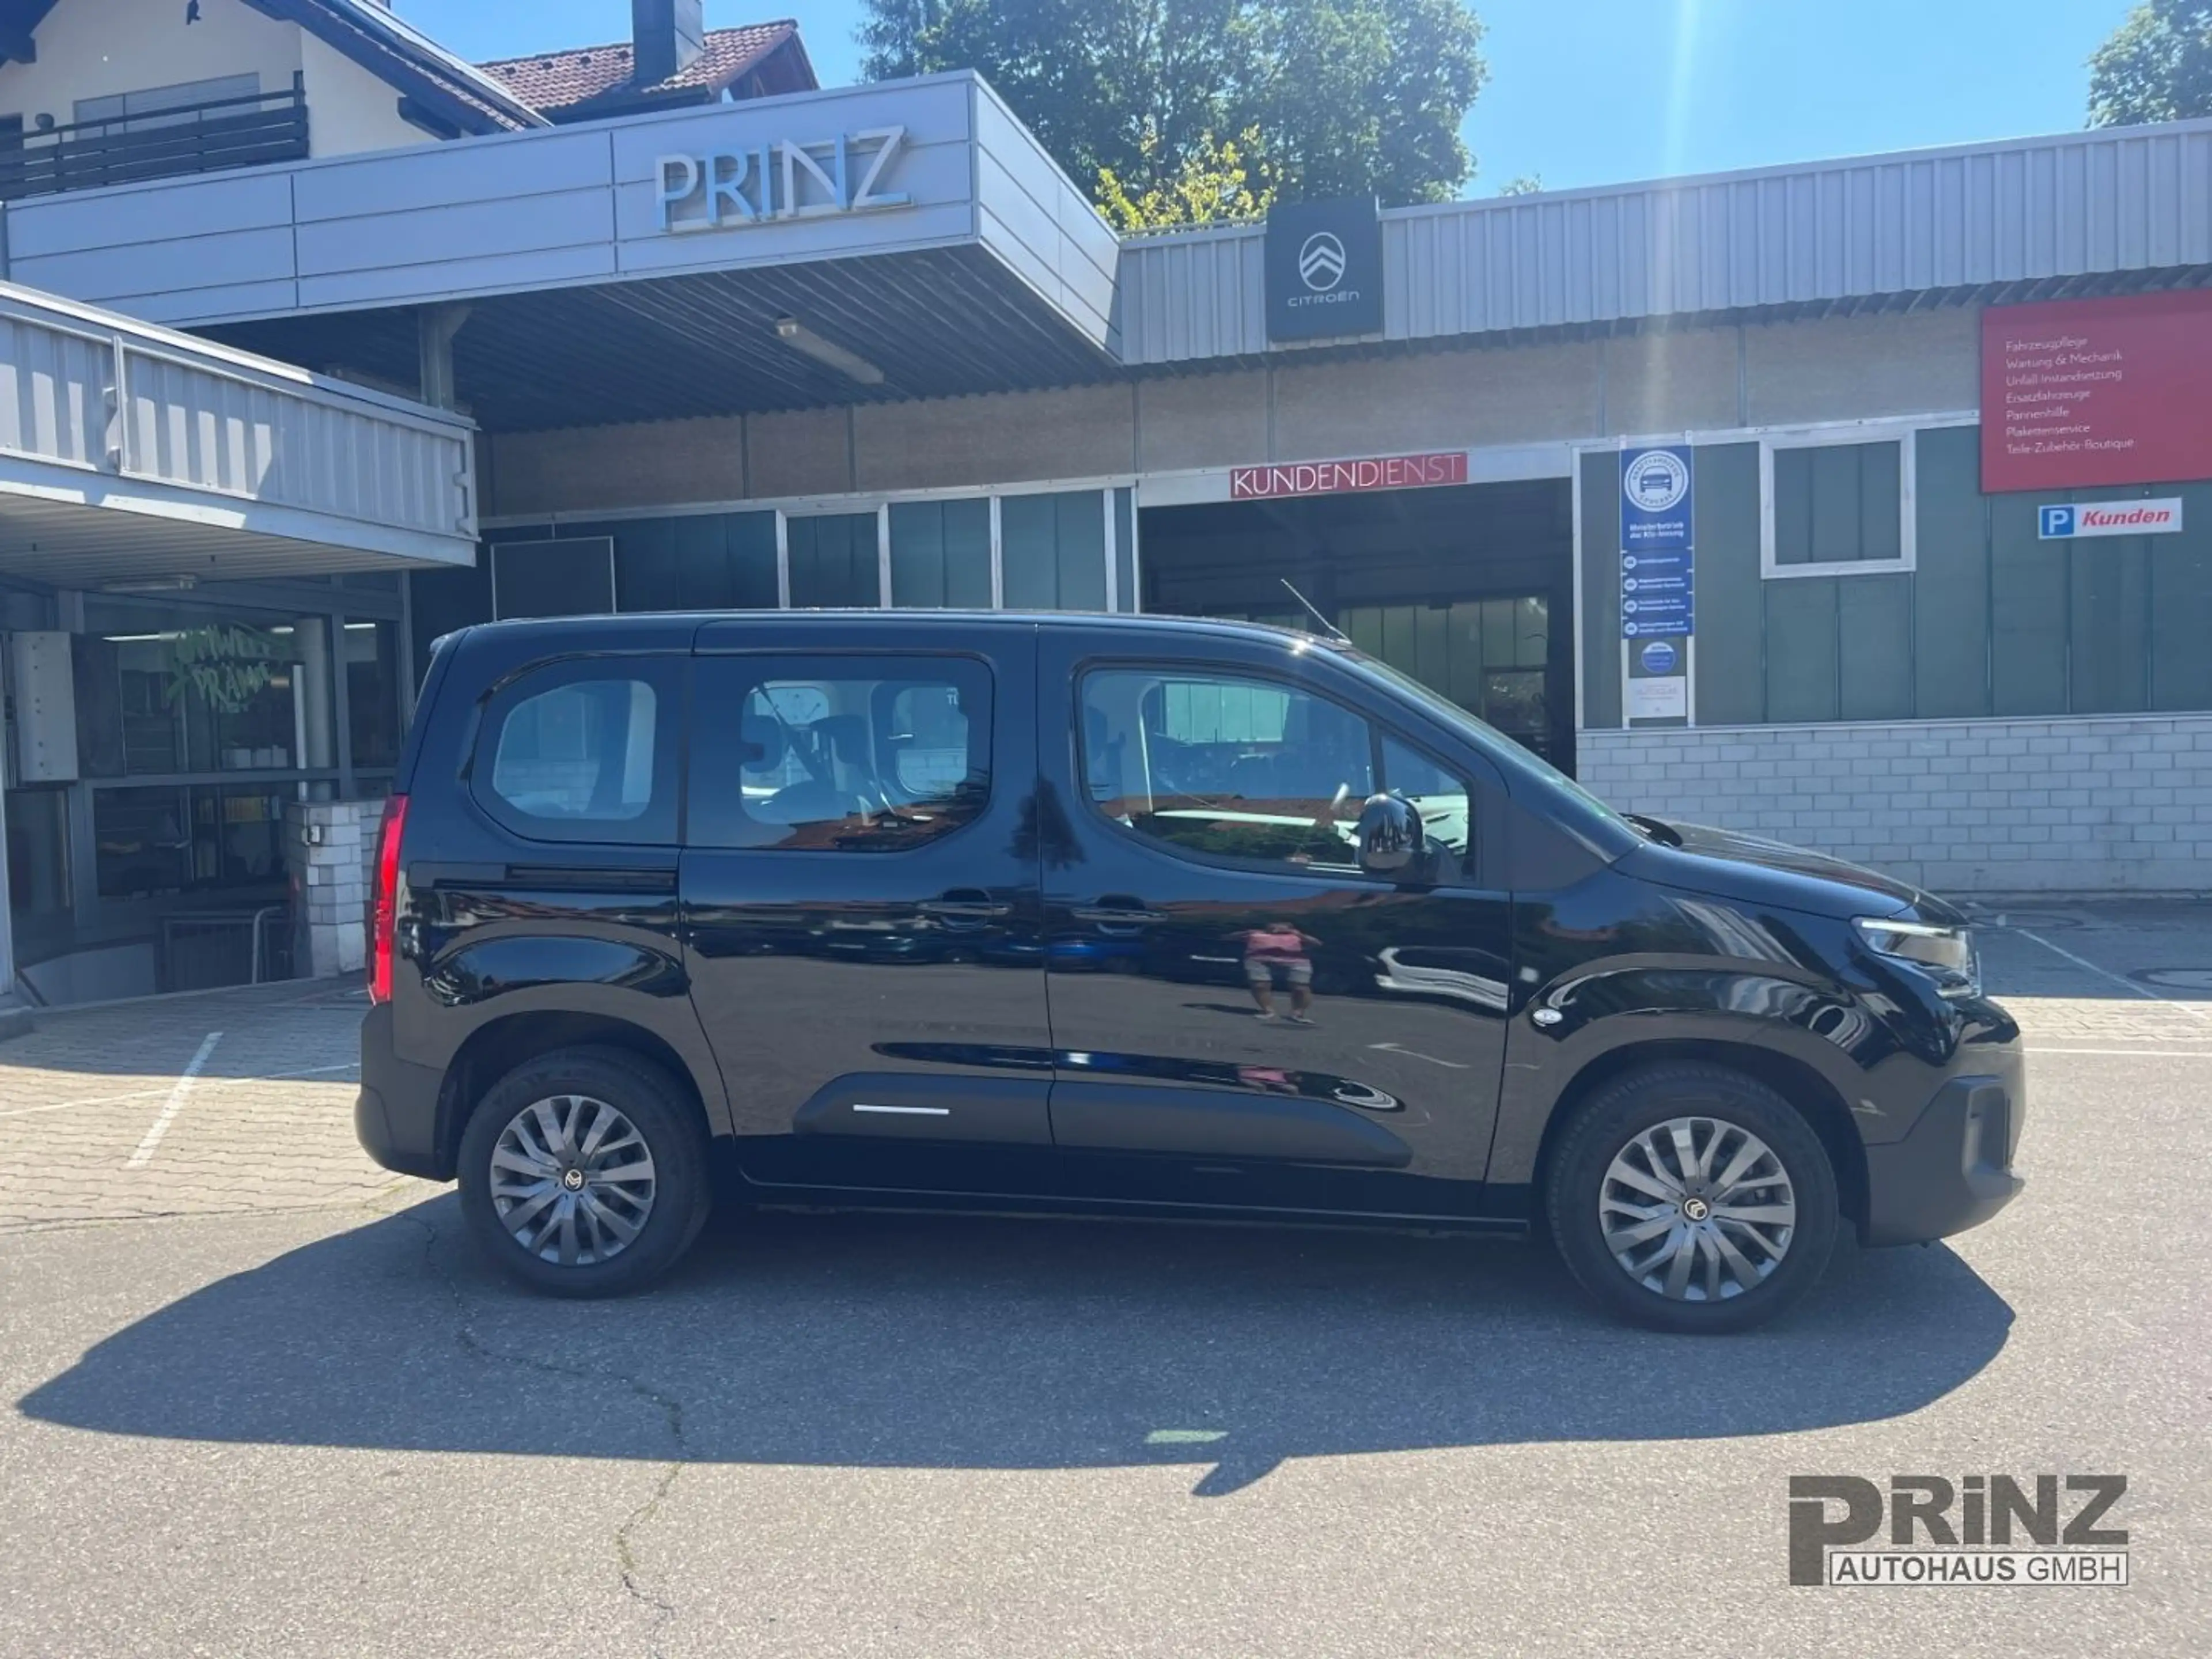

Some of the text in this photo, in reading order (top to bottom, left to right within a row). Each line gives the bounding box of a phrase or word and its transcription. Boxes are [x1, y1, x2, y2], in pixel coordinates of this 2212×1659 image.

[656, 125, 915, 232] PRINZ
[2006, 355, 2052, 370] Wartung
[2070, 349, 2122, 364] Mechanik
[2006, 374, 2038, 387] Unfall
[1234, 454, 1461, 495] KUNDENDIENST
[2048, 508, 2170, 534] P Kunden
